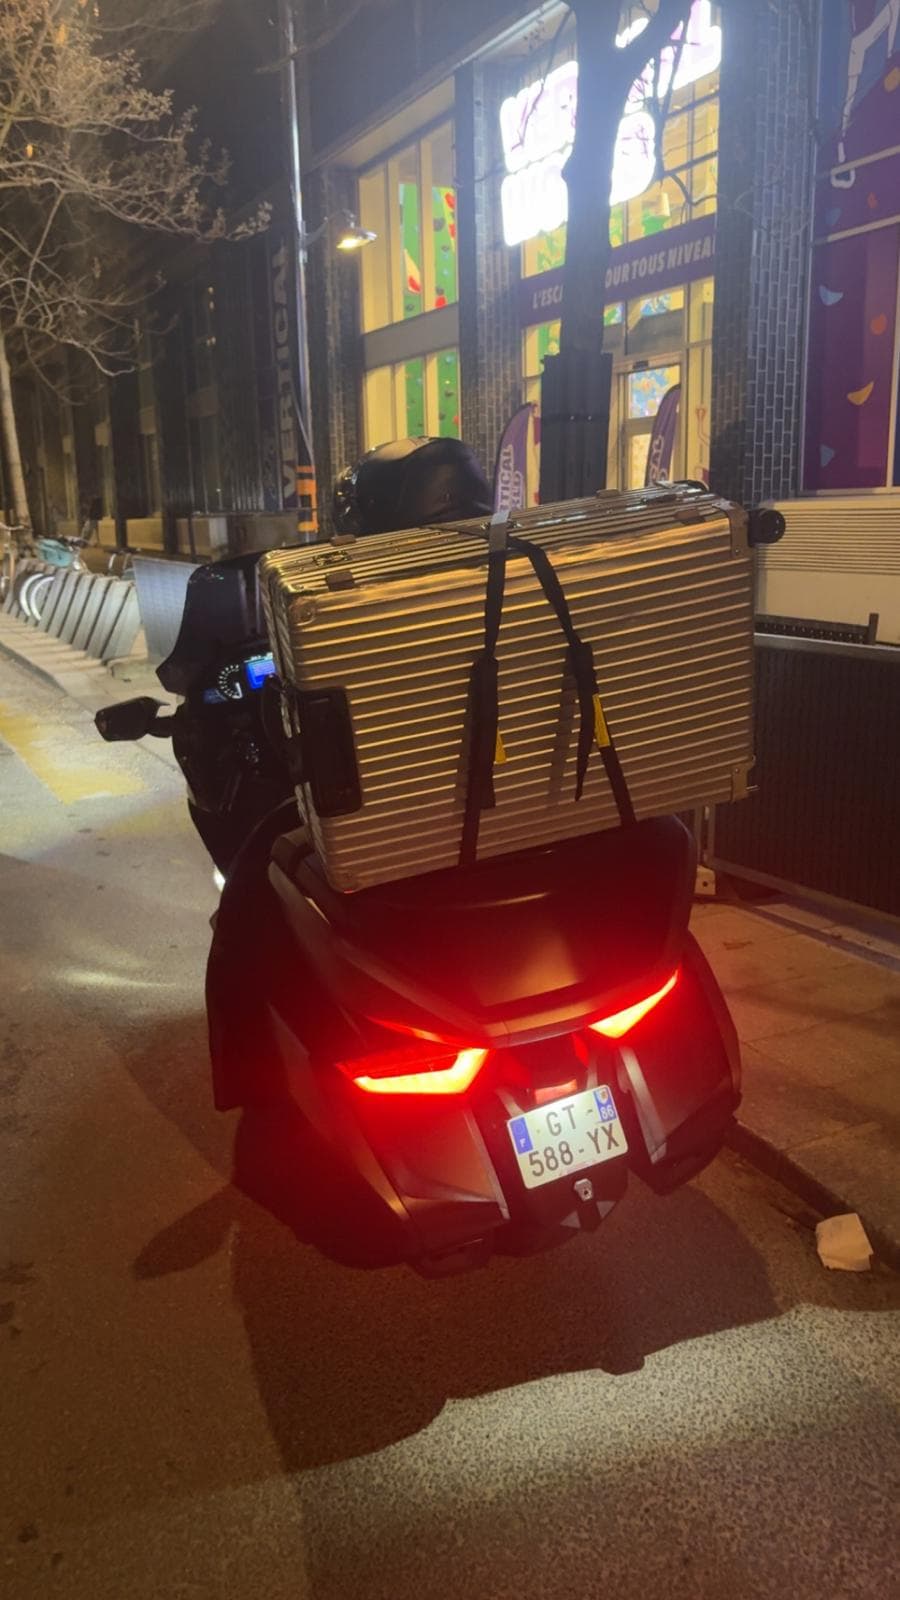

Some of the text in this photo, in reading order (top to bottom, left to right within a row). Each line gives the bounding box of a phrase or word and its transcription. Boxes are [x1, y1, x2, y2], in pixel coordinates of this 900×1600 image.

[606, 262, 630, 288] OUR
[631, 251, 666, 279] TOUS
[600, 1105, 615, 1120] 86
[528, 1123, 620, 1177] 588-YX
